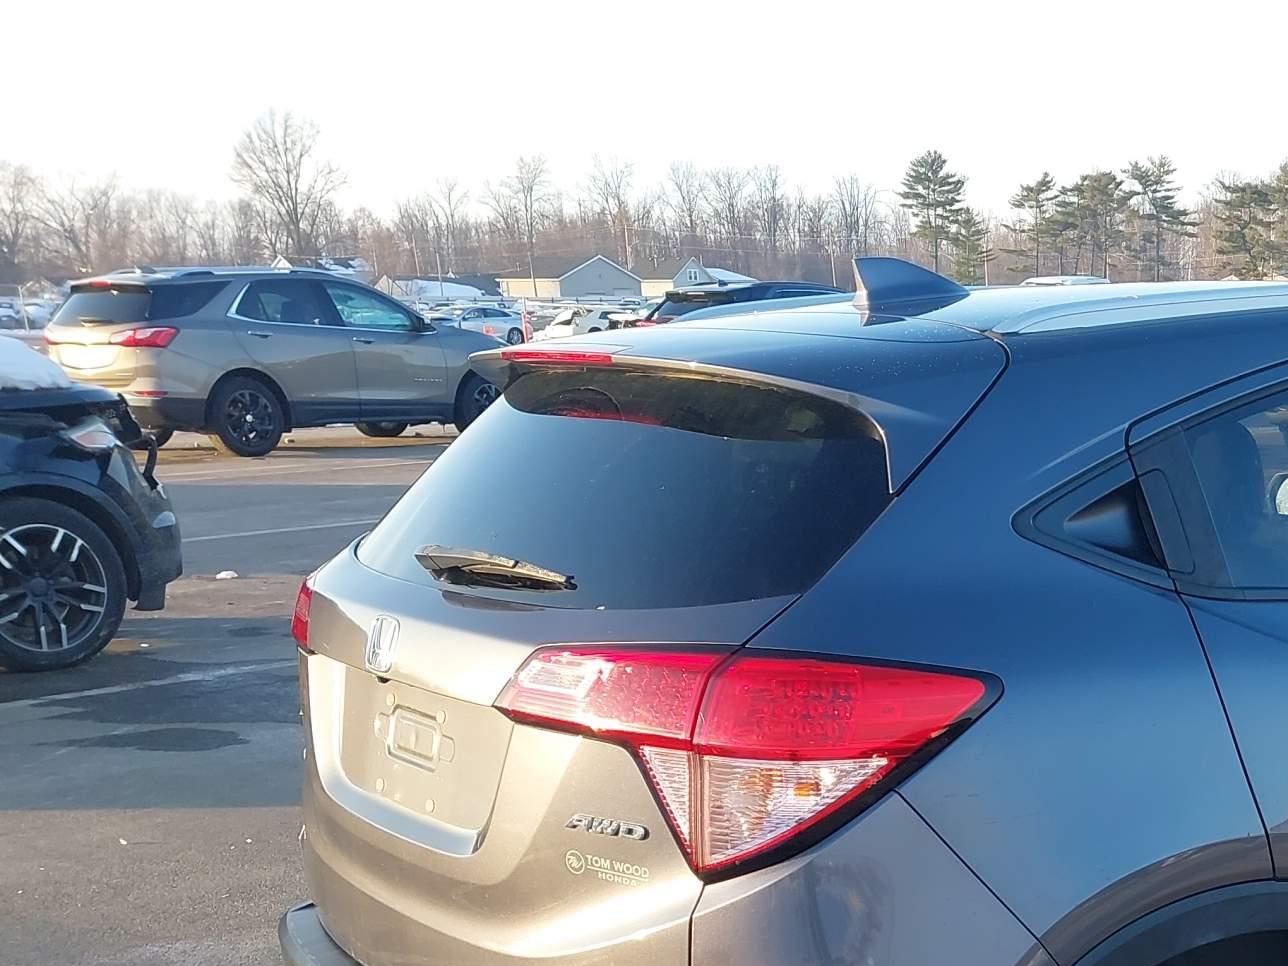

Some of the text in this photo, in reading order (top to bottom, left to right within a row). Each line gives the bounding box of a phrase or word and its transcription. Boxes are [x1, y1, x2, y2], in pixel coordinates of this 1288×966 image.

[565, 813, 650, 841] AWD
[585, 855, 650, 878] TOM WOOD
[598, 872, 638, 886] HONDA
